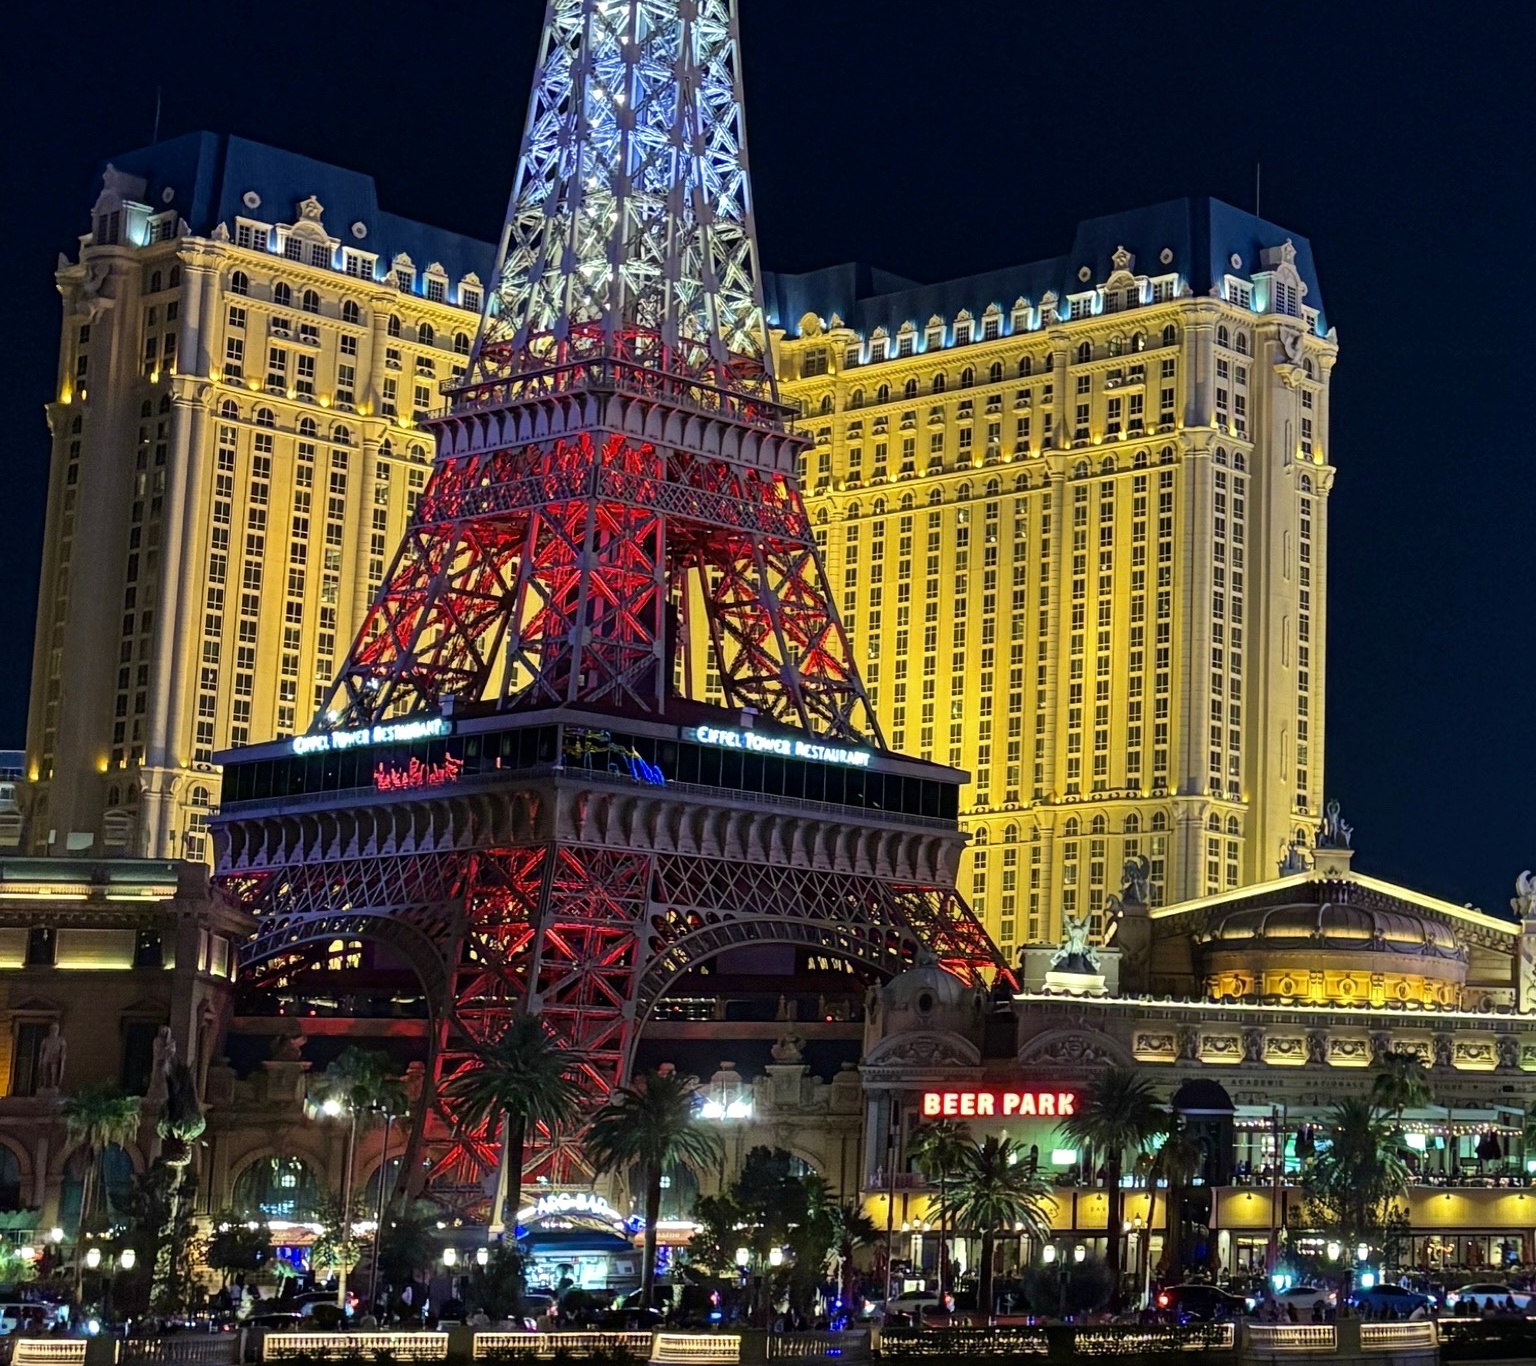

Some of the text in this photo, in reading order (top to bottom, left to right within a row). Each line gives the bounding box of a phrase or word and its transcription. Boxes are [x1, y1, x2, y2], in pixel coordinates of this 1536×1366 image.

[696, 726, 870, 767] EIFFEL TOWER RESTAURANT
[923, 1092, 1075, 1116] BEER PARK
